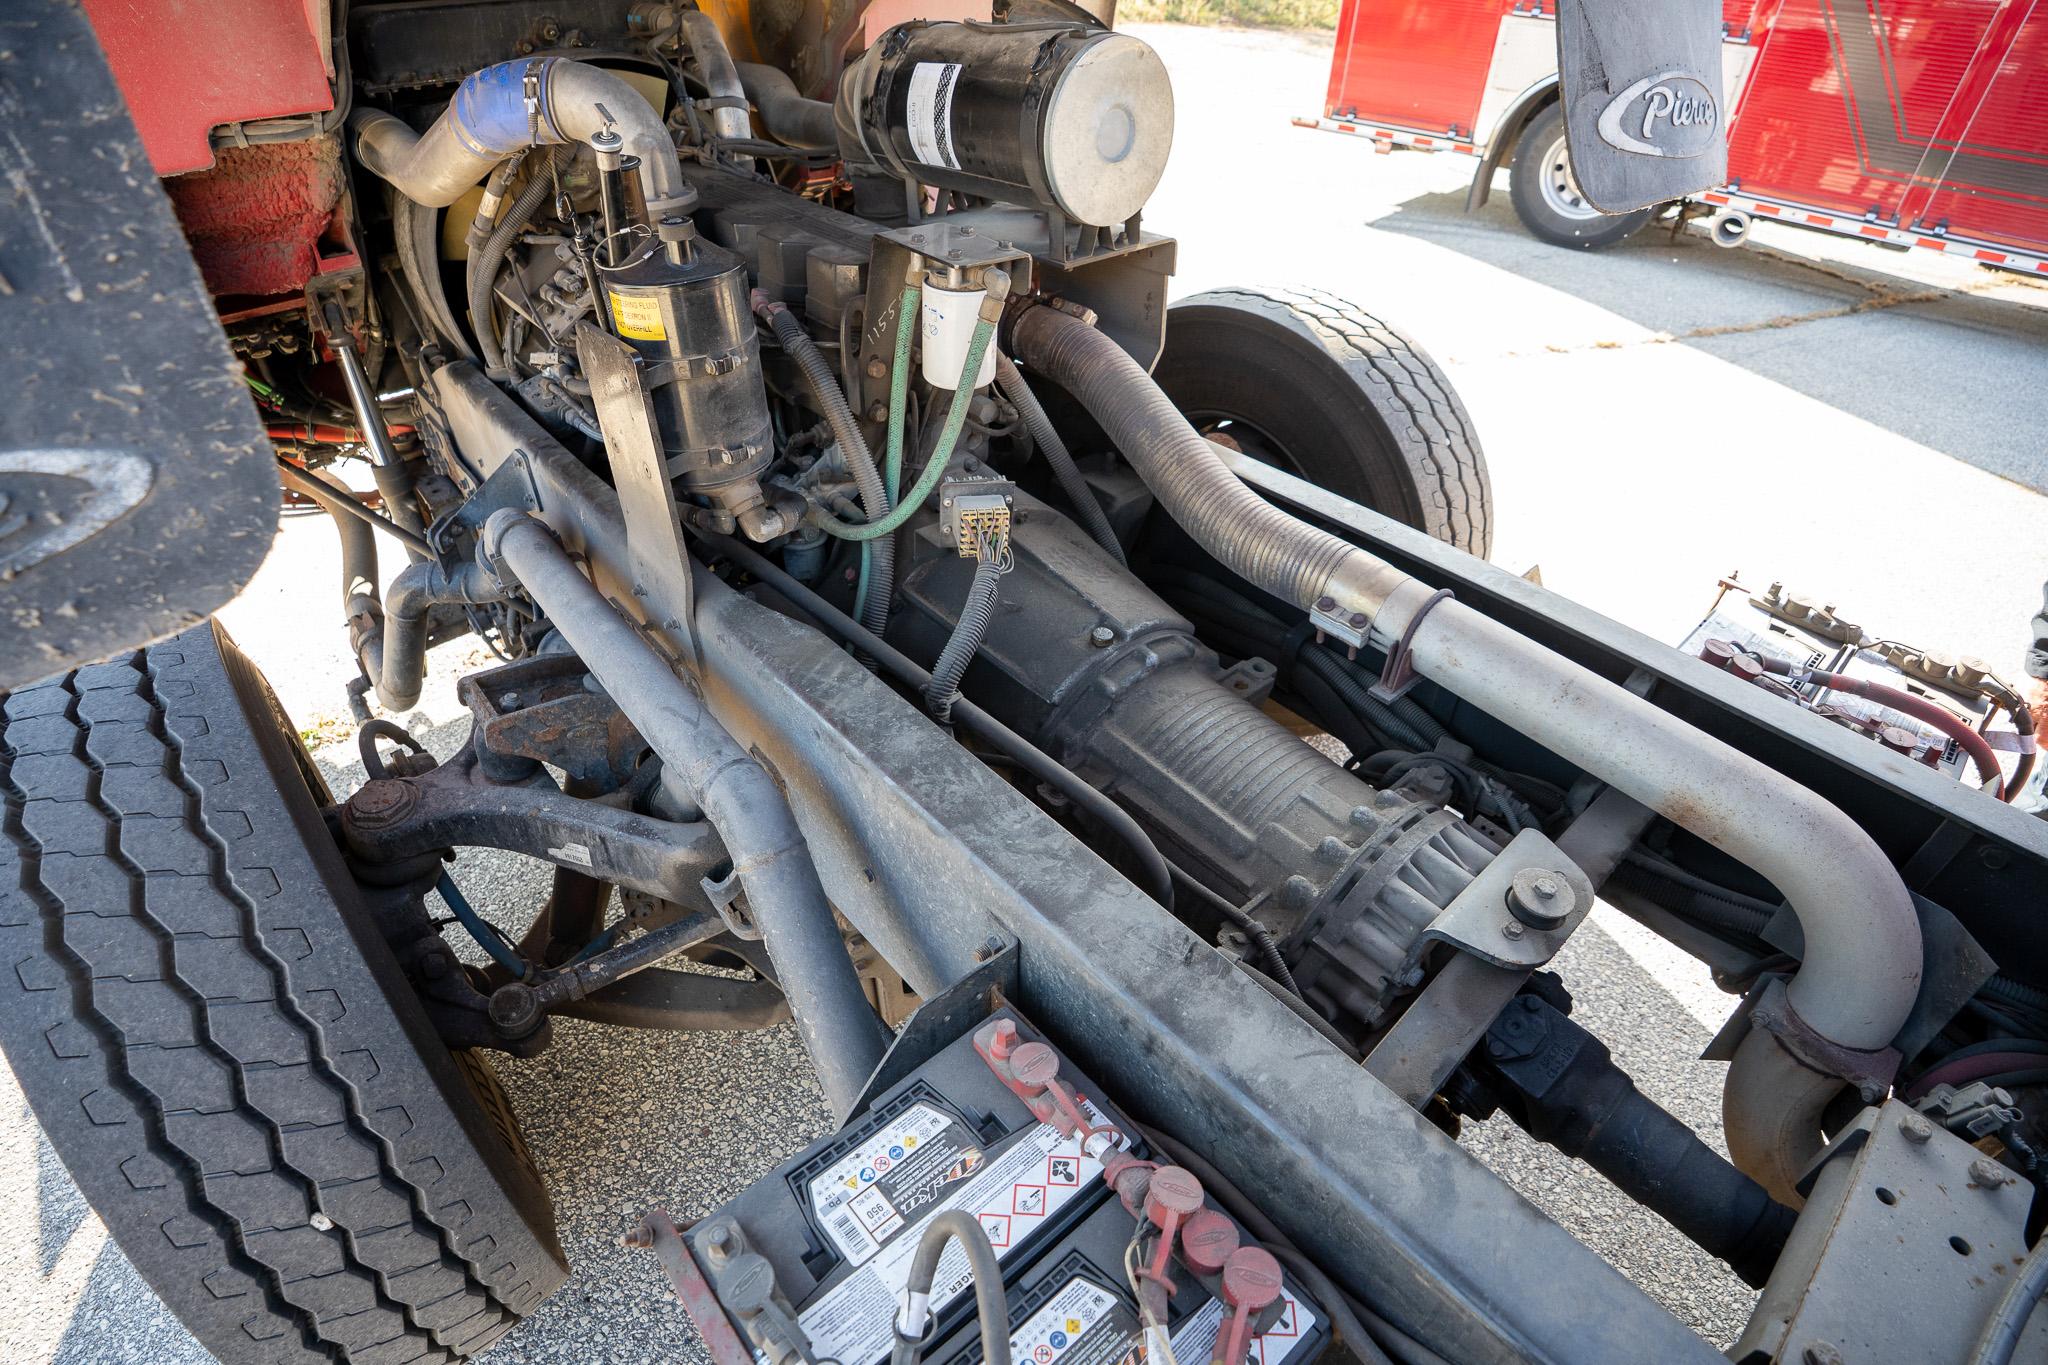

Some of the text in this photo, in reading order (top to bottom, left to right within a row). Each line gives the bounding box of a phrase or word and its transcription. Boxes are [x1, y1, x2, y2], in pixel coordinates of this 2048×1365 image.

[1643, 86, 1712, 139] Pierce
[639, 302, 658, 310] FLUID
[902, 1157, 970, 1215] Deka
[824, 1191, 836, 1201] 12V
[828, 1196, 842, 1209] Pb
[866, 1203, 884, 1220] 950
[949, 1272, 974, 1294] NGER
